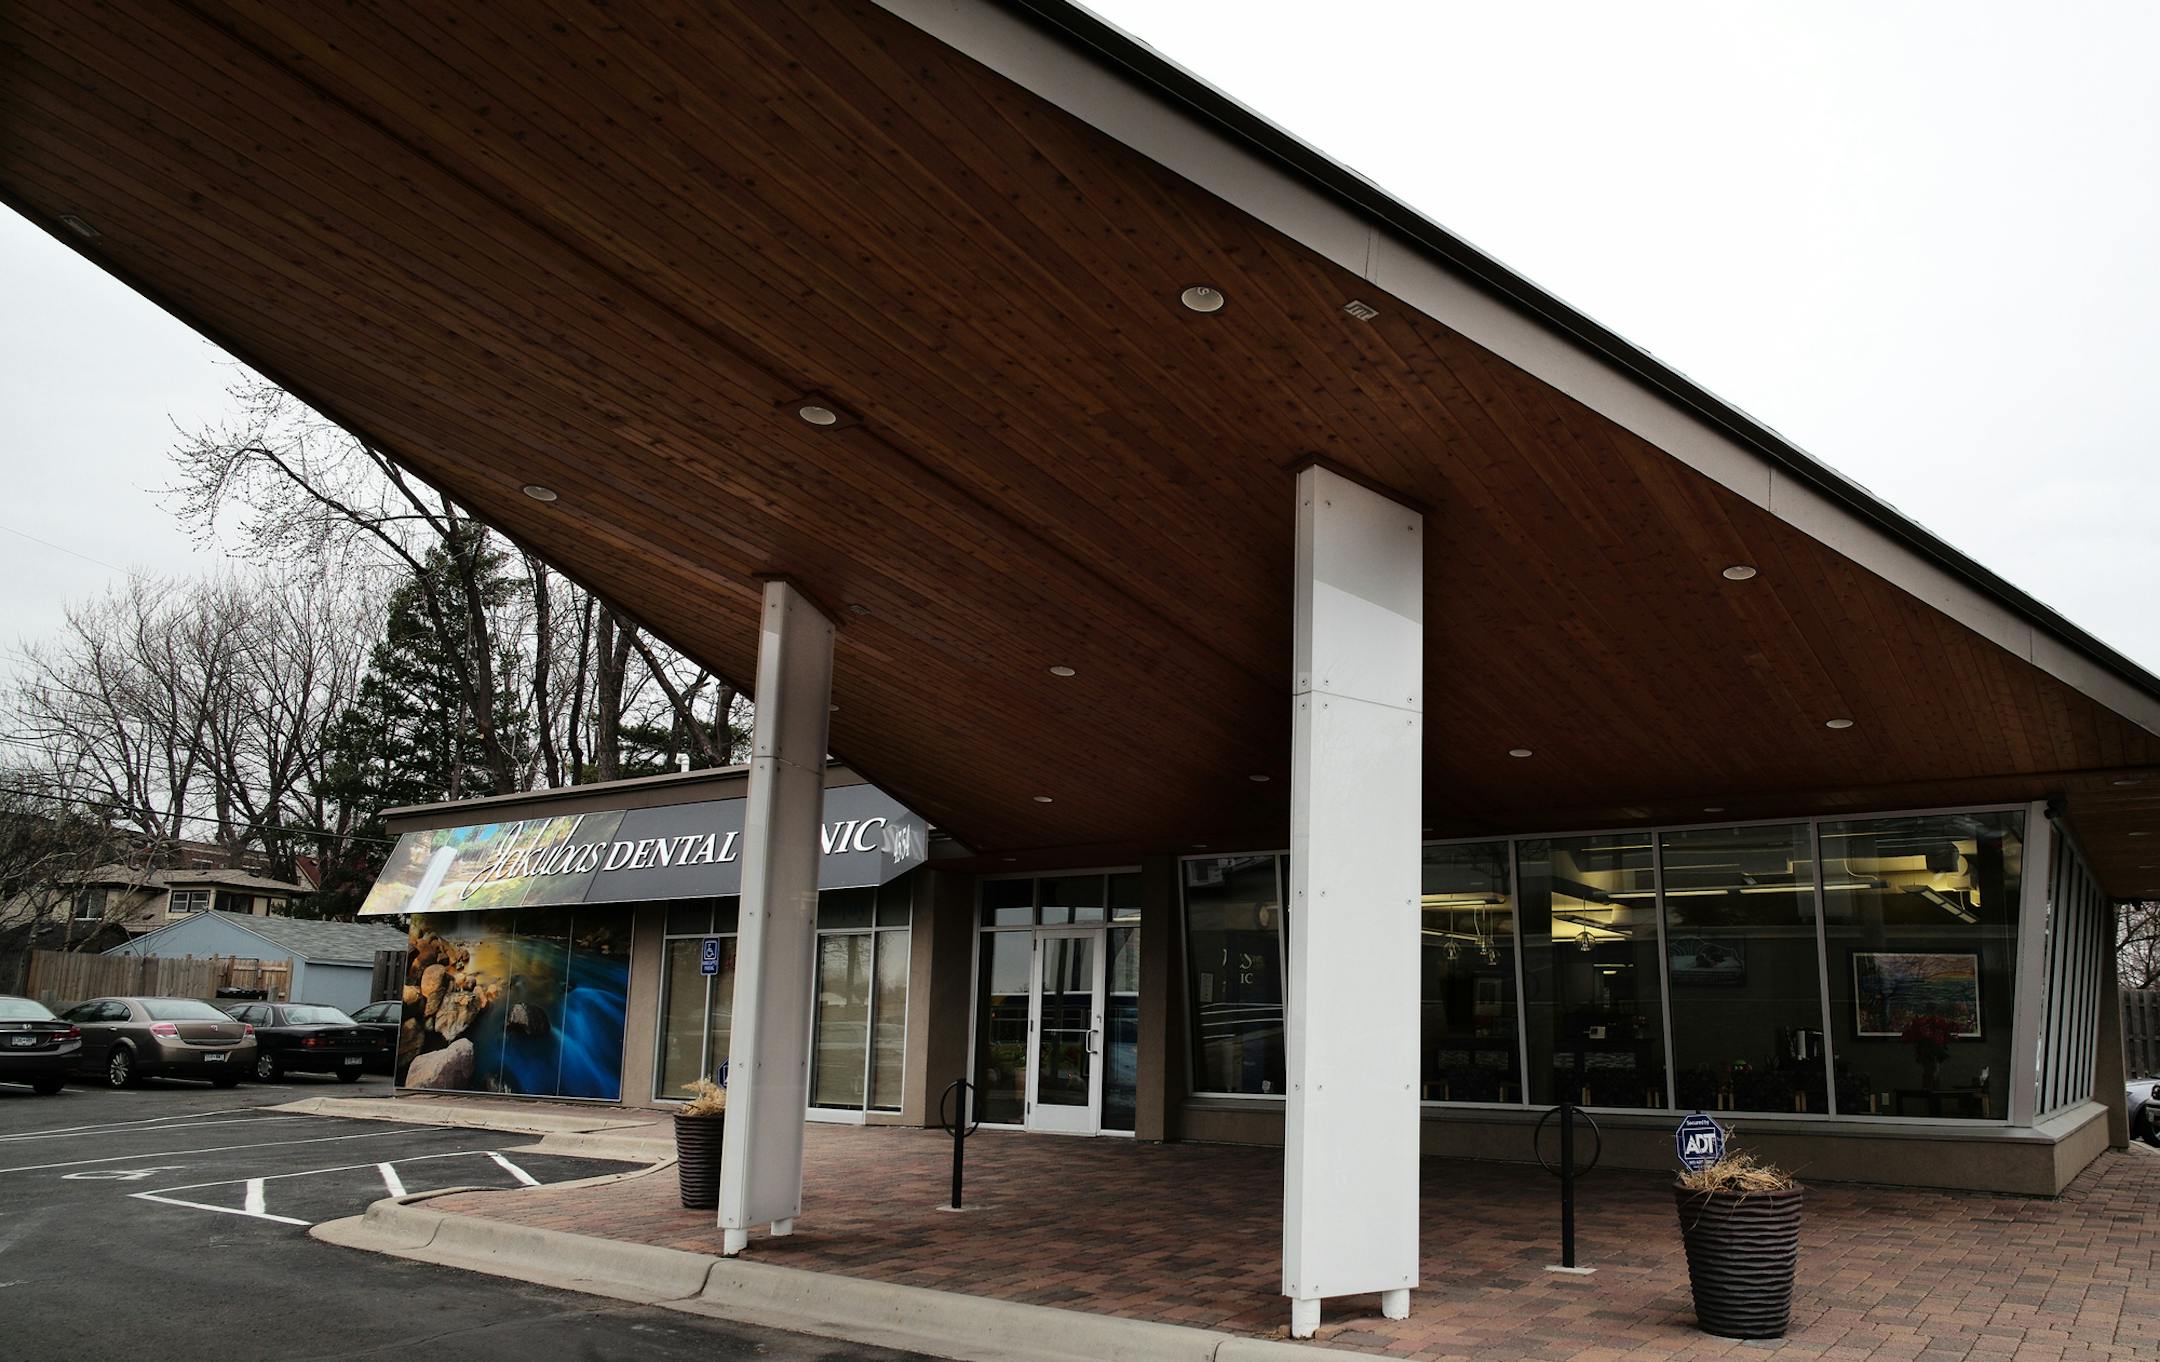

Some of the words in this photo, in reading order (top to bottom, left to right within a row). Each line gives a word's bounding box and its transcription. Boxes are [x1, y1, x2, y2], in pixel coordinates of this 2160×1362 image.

[460, 814, 606, 900] Jakubas
[603, 831, 739, 872] DENTAL
[821, 817, 888, 855] NIC
[1685, 1133, 1715, 1155] ADT
